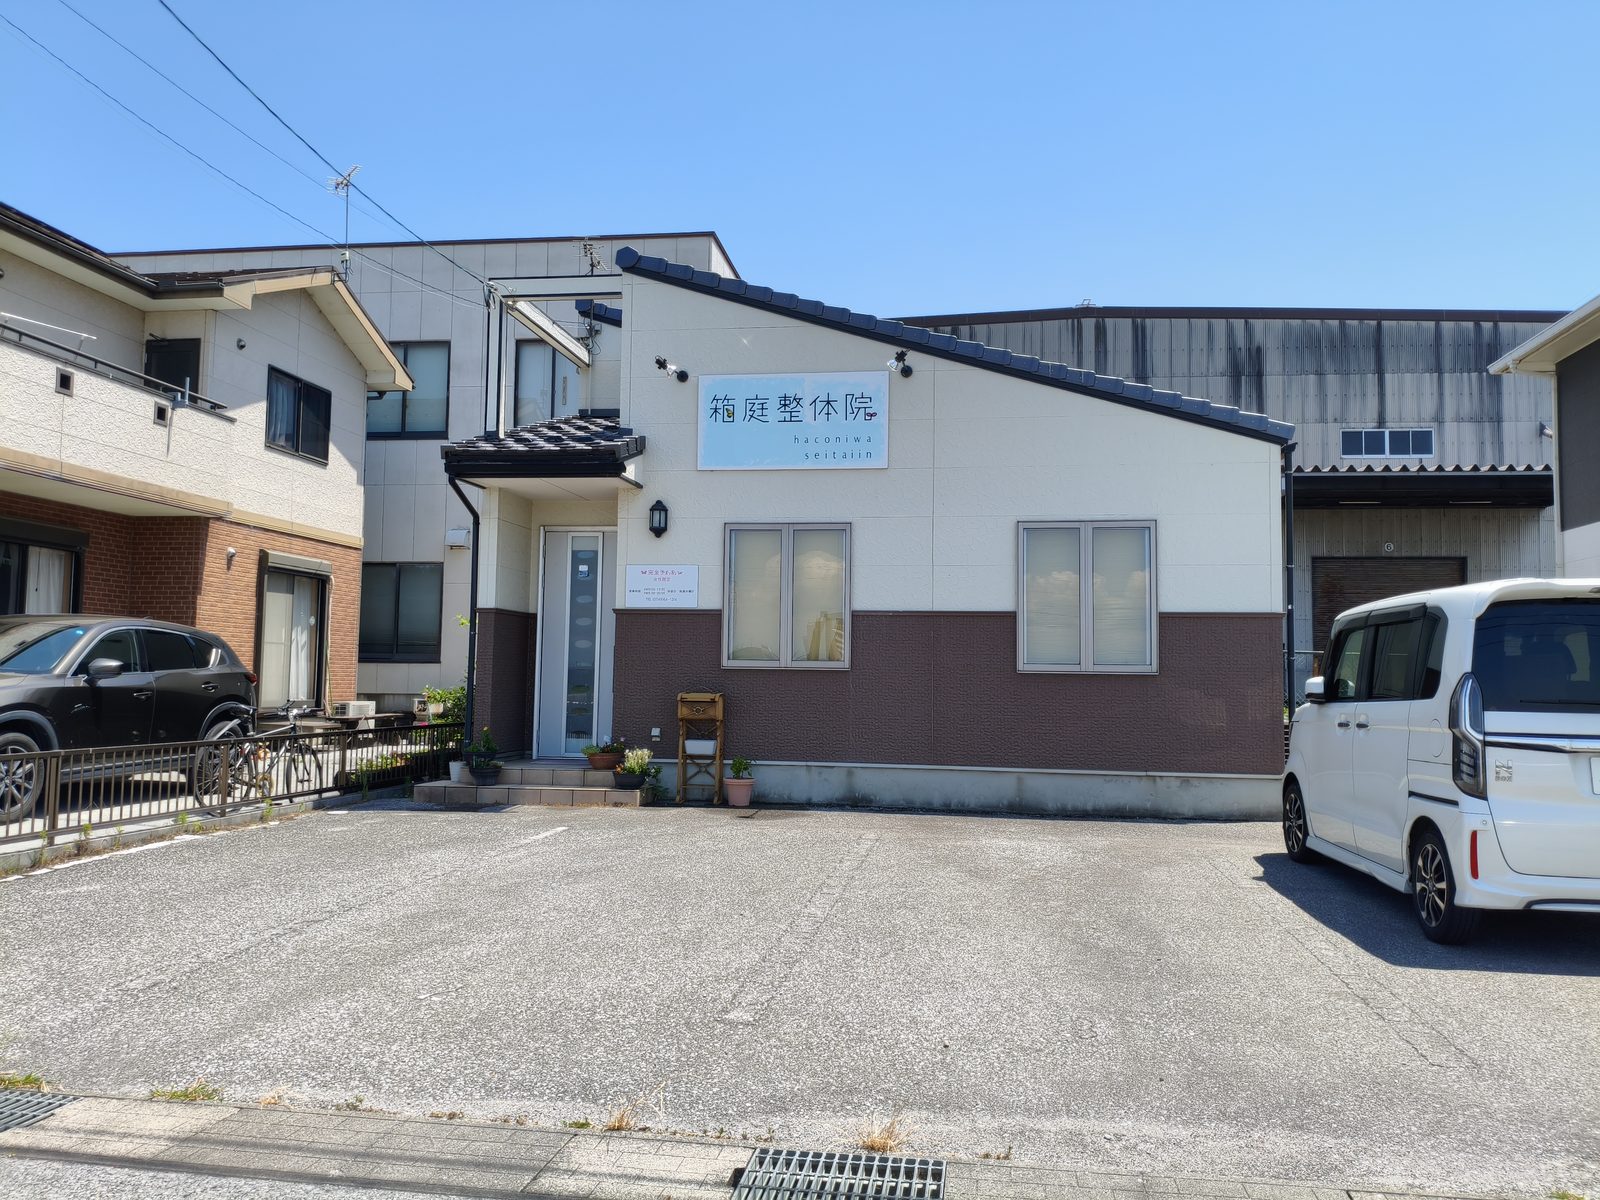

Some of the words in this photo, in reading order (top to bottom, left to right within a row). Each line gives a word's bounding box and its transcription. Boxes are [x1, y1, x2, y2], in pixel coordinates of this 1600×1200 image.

[709, 392, 874, 423] 箱庭整体院
[793, 434, 872, 444] haconiwa
[804, 450, 872, 460] seitaiin
